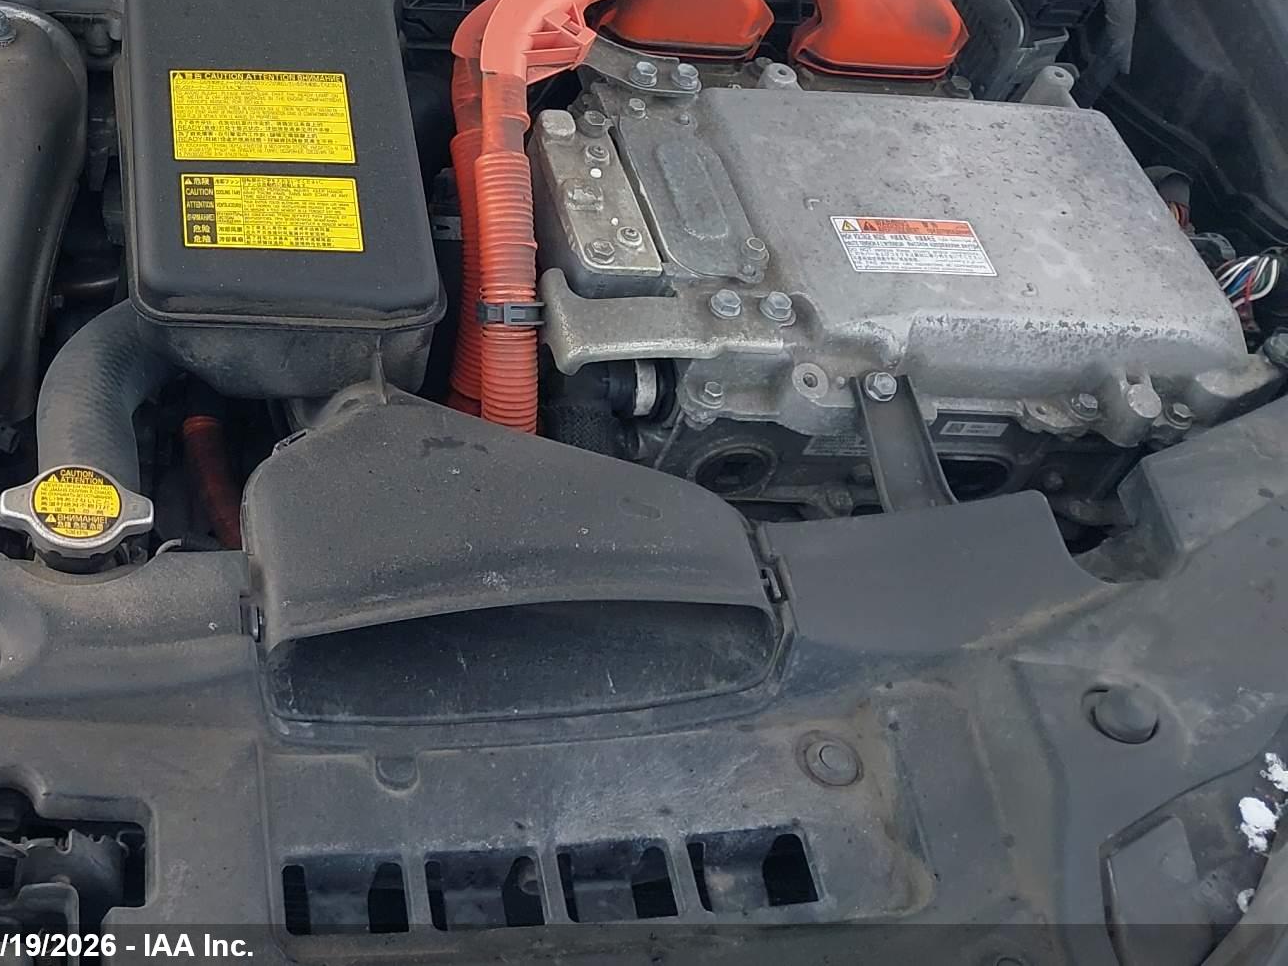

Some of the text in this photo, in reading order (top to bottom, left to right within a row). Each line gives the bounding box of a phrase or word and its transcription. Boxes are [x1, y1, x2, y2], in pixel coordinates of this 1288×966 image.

[245, 73, 296, 81] ATTENTION
[185, 187, 214, 196] CAUTION
[186, 200, 215, 209] ATTENTION
[60, 470, 94, 478] CAUTION
[60, 477, 103, 485] ATTENTION
[57, 514, 108, 524] ВНИМАНИЕ!
